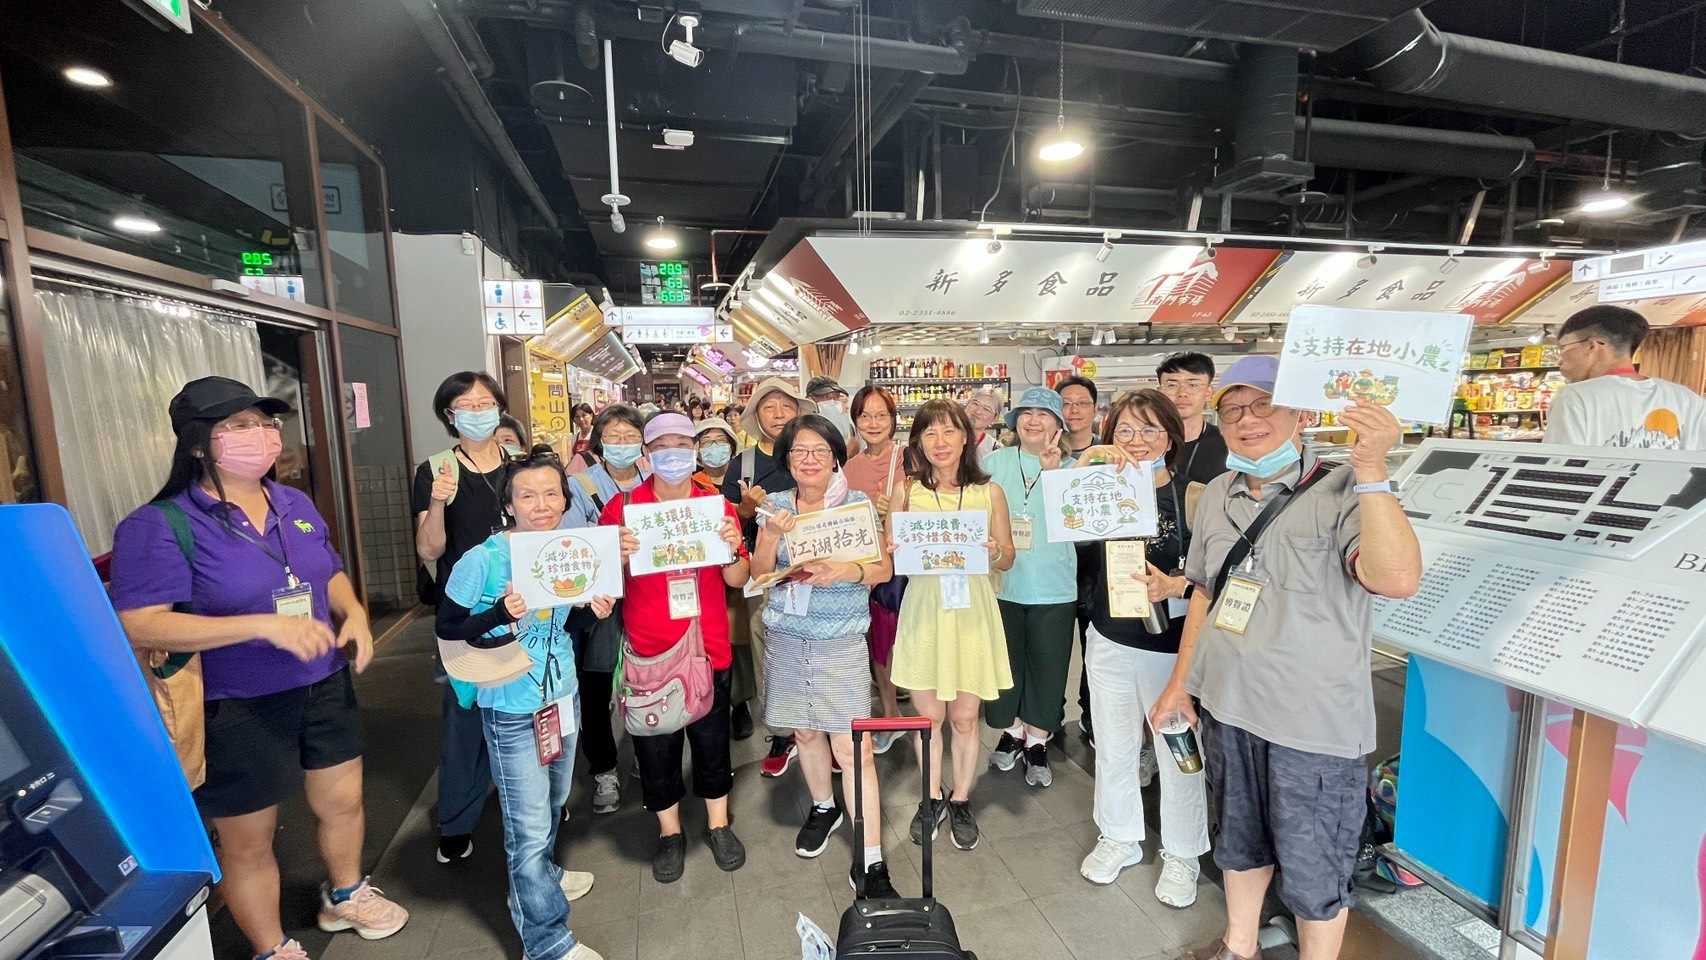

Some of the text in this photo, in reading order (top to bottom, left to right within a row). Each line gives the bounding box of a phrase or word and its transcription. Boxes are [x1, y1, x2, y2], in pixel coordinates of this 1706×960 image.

[925, 268, 1119, 297] 新多食品
[1296, 277, 1447, 301] 新多食品
[1302, 335, 1442, 370] 支持在地小農
[1071, 490, 1123, 506] 支持在地
[641, 506, 694, 531] 友善環境
[1086, 503, 1111, 517] 小農
[662, 519, 713, 540] 永續生活
[911, 530, 968, 543] 珍惜食物
[791, 528, 875, 558] 江湖拾光
[547, 560, 592, 574] 珍惜食物
